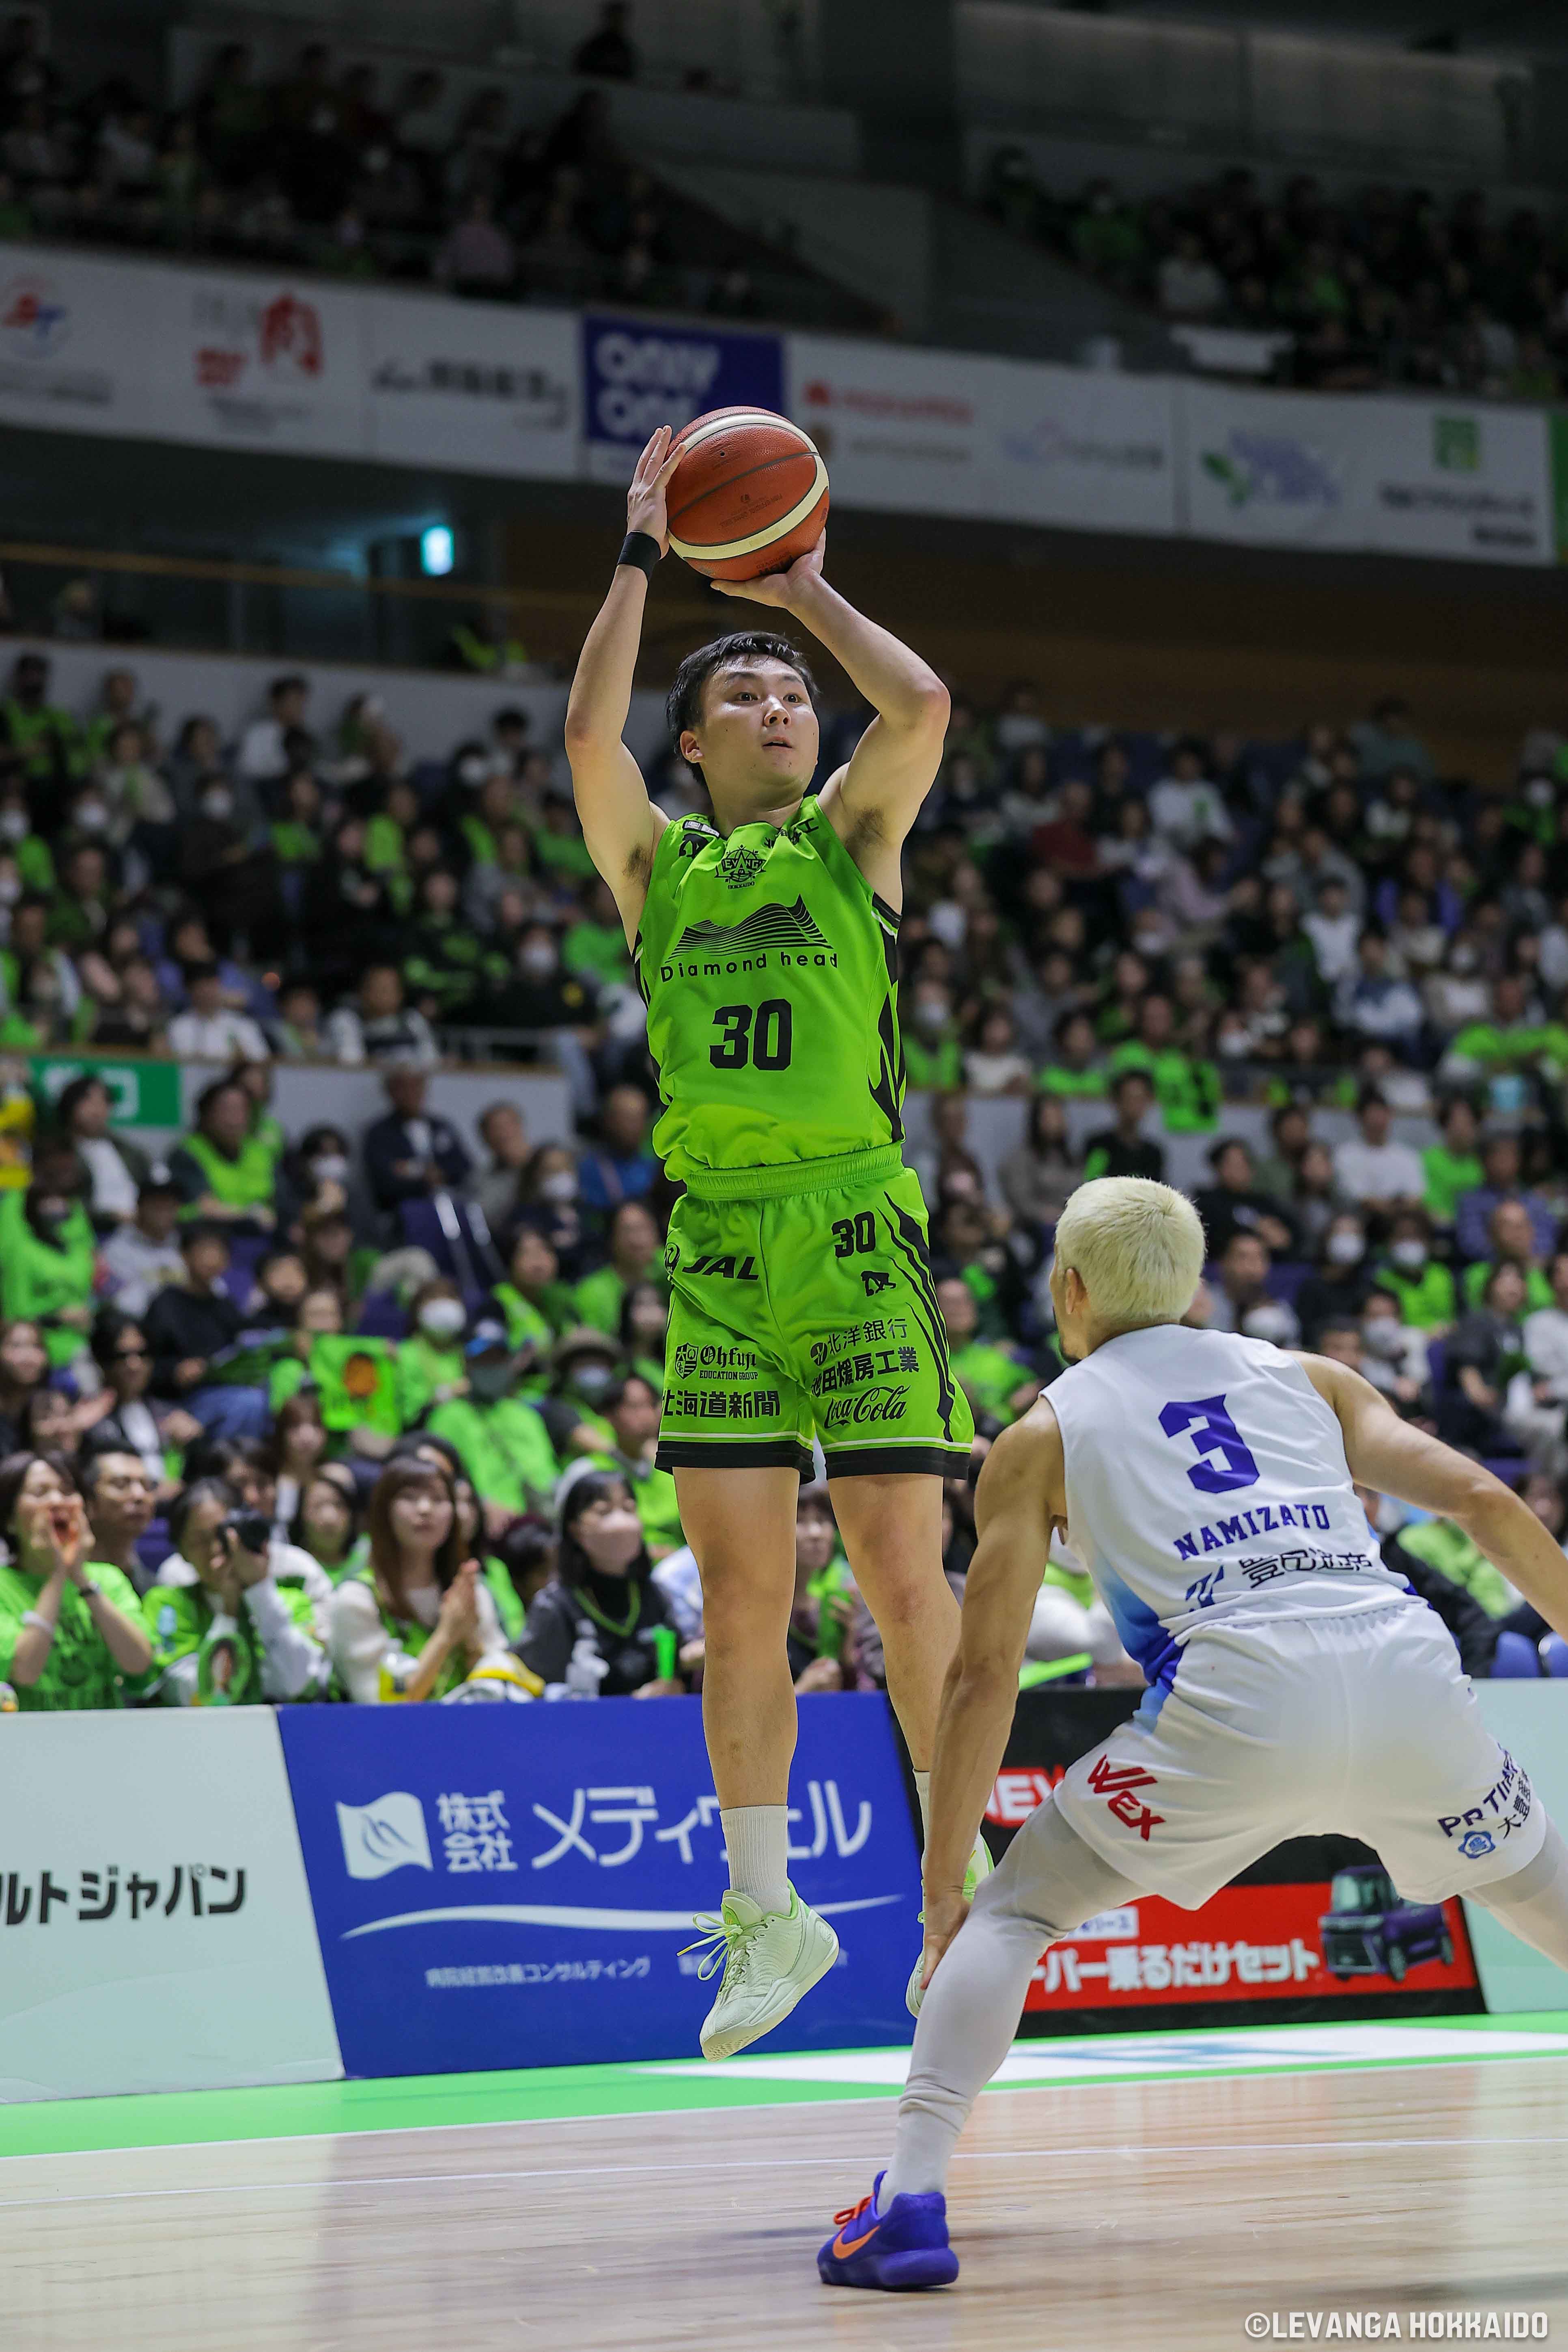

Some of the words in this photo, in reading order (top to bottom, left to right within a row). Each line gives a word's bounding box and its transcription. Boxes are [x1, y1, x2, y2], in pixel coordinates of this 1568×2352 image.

[660, 953, 767, 982] Diamond
[780, 951, 838, 969] head
[709, 998, 792, 1071] 30
[831, 1210, 876, 1258] 30
[682, 1256, 759, 1280] JAL
[700, 1344, 757, 1371] Ohfuji
[828, 1318, 907, 1355] 北洋銀行
[699, 1370, 738, 1380] EDUCATION
[739, 1372, 758, 1380] GROUP
[1158, 1394, 1260, 1494] 3
[1174, 1504, 1330, 1561] NAMIZATO
[437, 1790, 510, 1833] 株式
[442, 1830, 518, 1872] 会社
